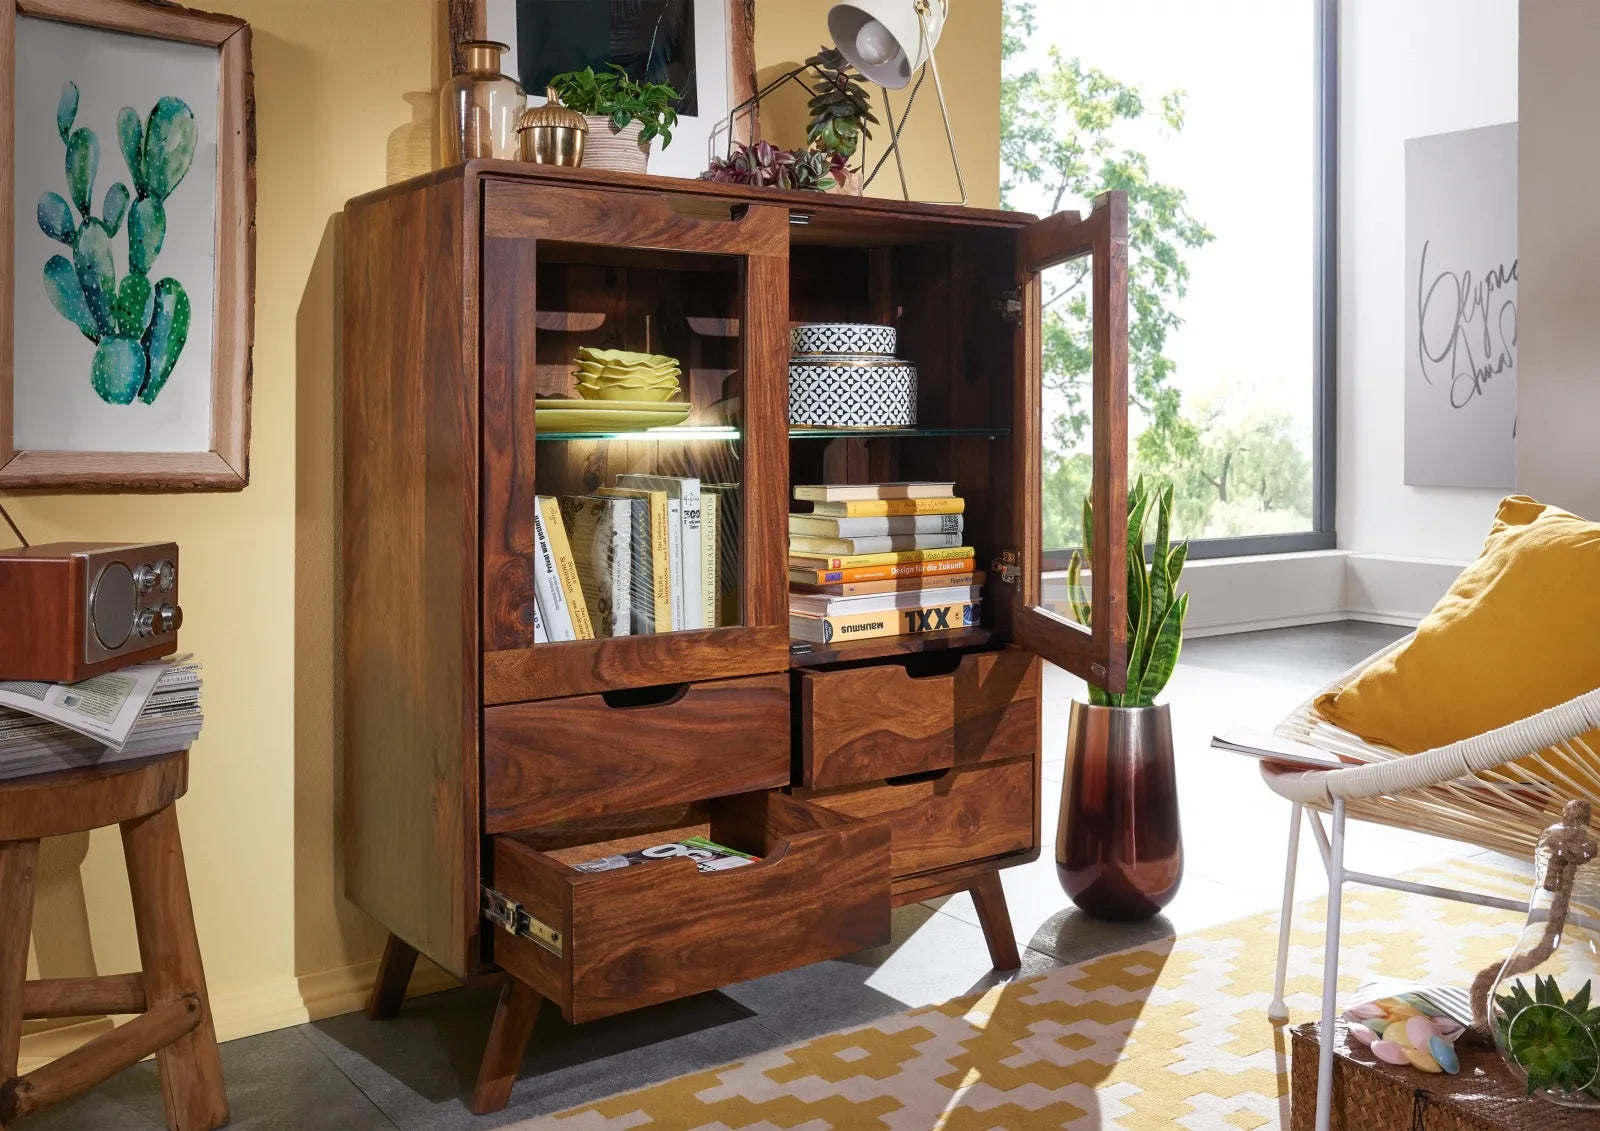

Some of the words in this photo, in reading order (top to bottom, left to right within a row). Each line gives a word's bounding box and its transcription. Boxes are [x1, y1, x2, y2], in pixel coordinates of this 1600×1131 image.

[543, 553, 554, 575] Privat
[890, 565, 914, 577] Design
[915, 564, 925, 573] für
[927, 564, 937, 572] die
[938, 561, 964, 571] Zukunft
[904, 607, 951, 633] XXL
